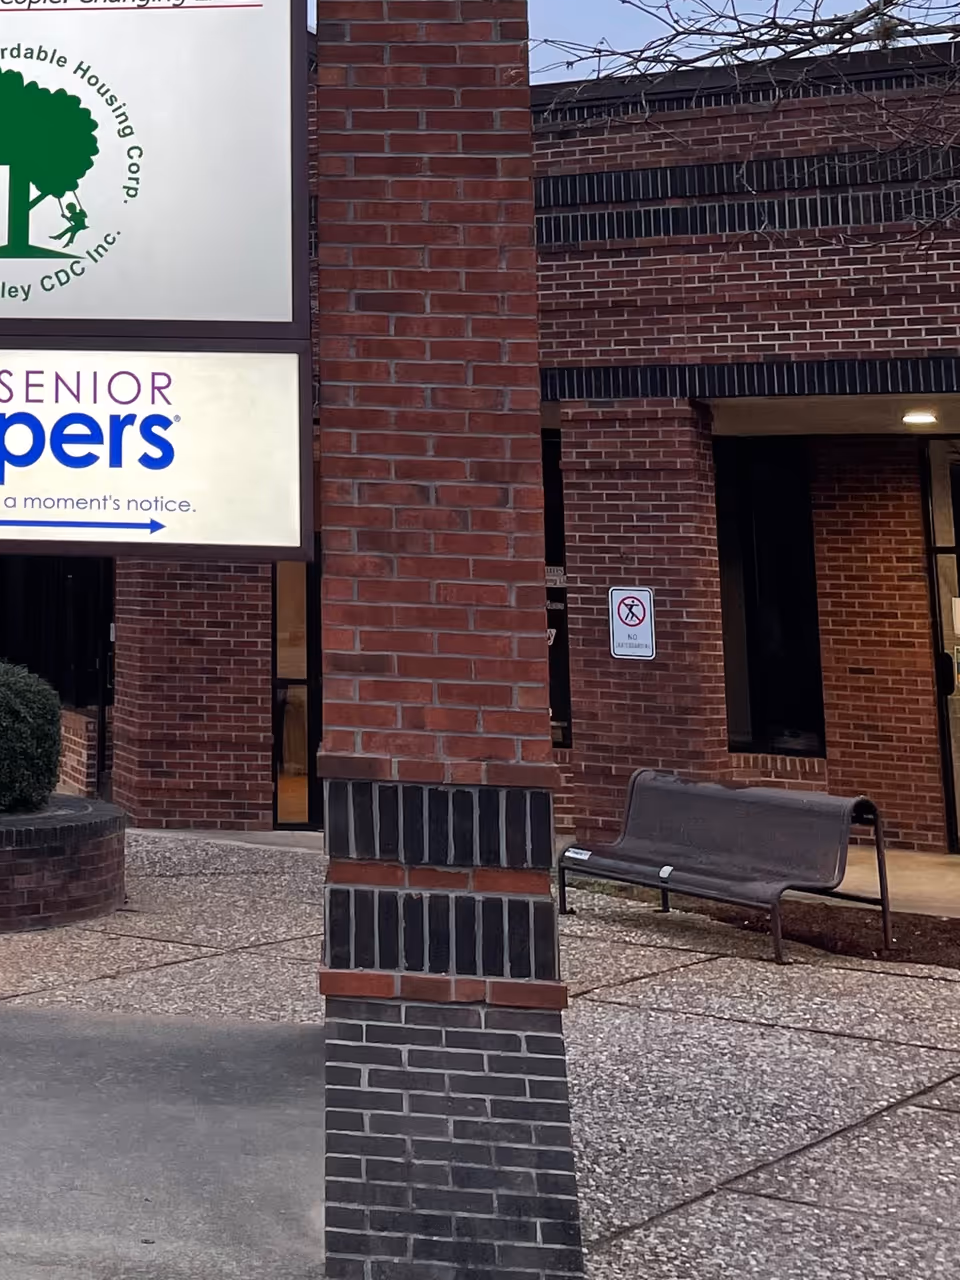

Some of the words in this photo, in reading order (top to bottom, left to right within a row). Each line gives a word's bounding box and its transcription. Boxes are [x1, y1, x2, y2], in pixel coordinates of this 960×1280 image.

[73, 61, 134, 138] Housing
[123, 146, 143, 203] Corp.
[41, 261, 85, 291] CDC
[86, 231, 120, 263] Inc.
[4, 496, 16, 509] a
[24, 494, 120, 511] moment's
[128, 495, 196, 513] notice.
[627, 633, 638, 641] NO
